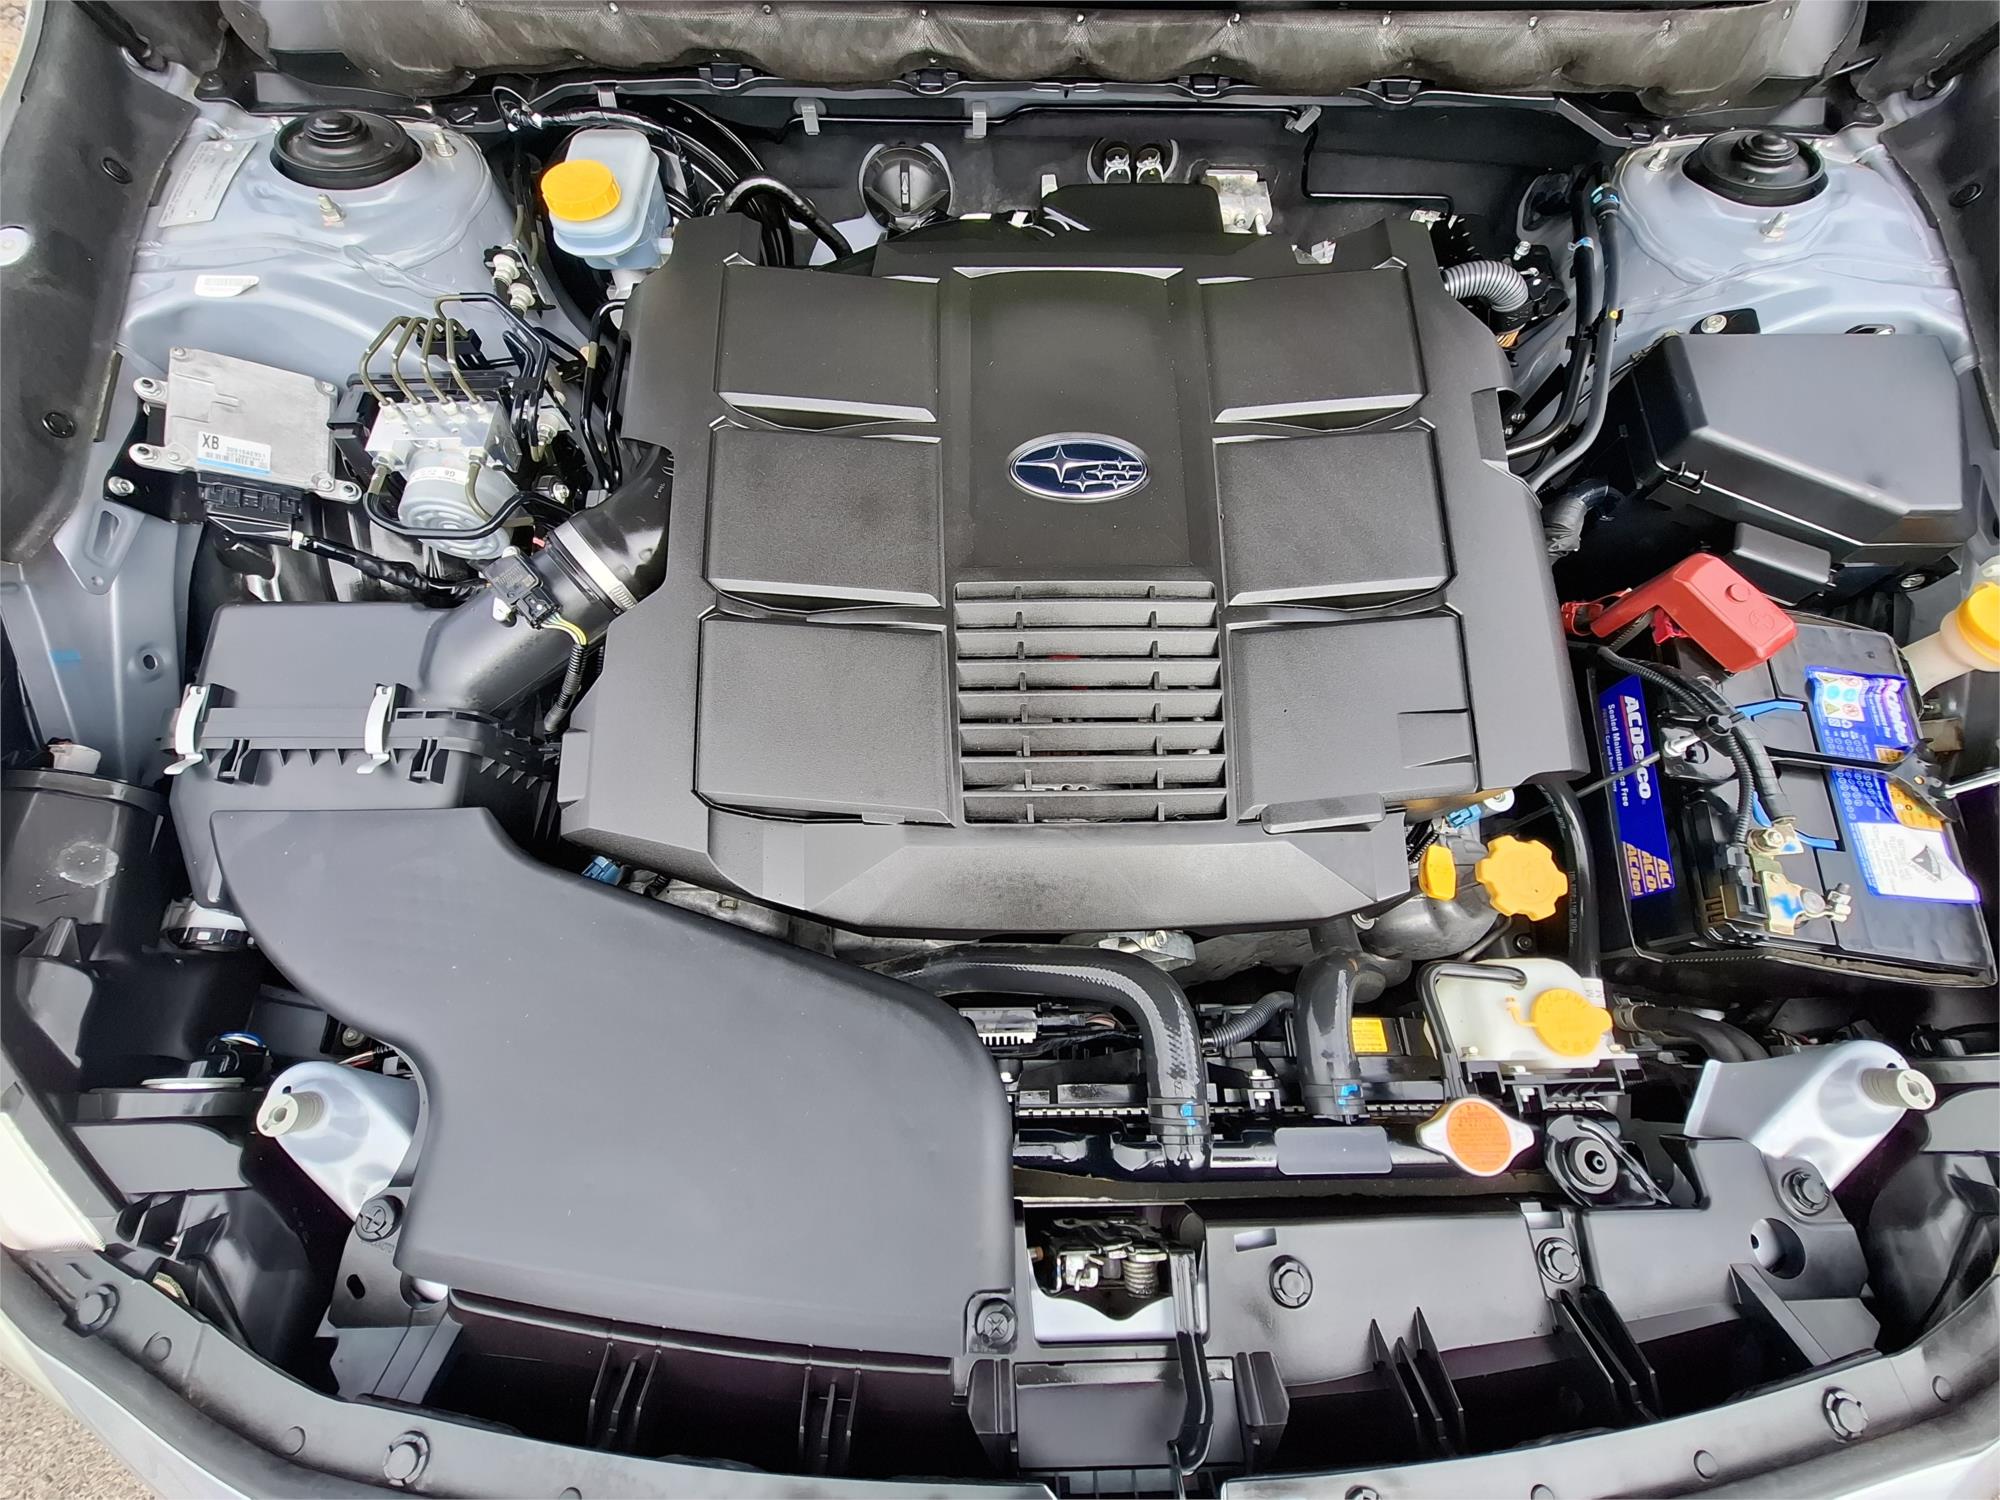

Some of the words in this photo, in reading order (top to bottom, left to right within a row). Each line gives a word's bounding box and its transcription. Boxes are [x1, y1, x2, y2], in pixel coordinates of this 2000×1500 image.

[202, 433, 220, 450] XB
[1608, 703, 1619, 732] Sealed
[1612, 732, 1627, 787] Maintenace
[1621, 787, 1629, 807] Free
[1641, 849, 1657, 892] ACD
[1656, 858, 1672, 889] AC
